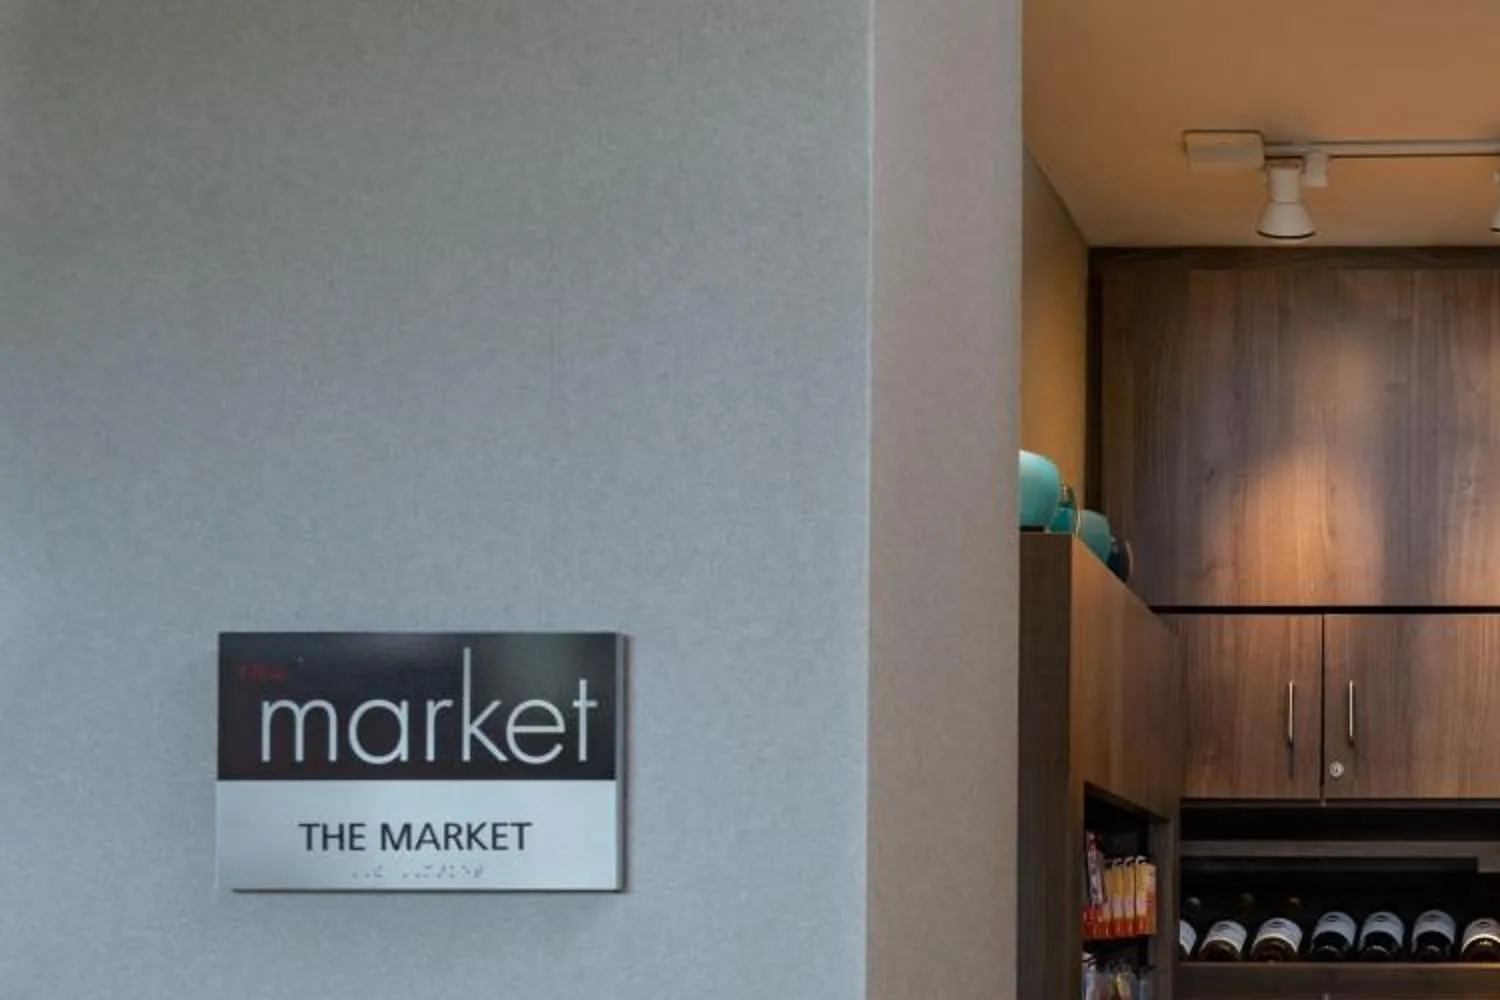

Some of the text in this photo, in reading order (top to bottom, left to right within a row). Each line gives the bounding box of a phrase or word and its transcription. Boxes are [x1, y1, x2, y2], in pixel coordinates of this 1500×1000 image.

[260, 646, 599, 765] market
[298, 822, 533, 852] THE MARKET
